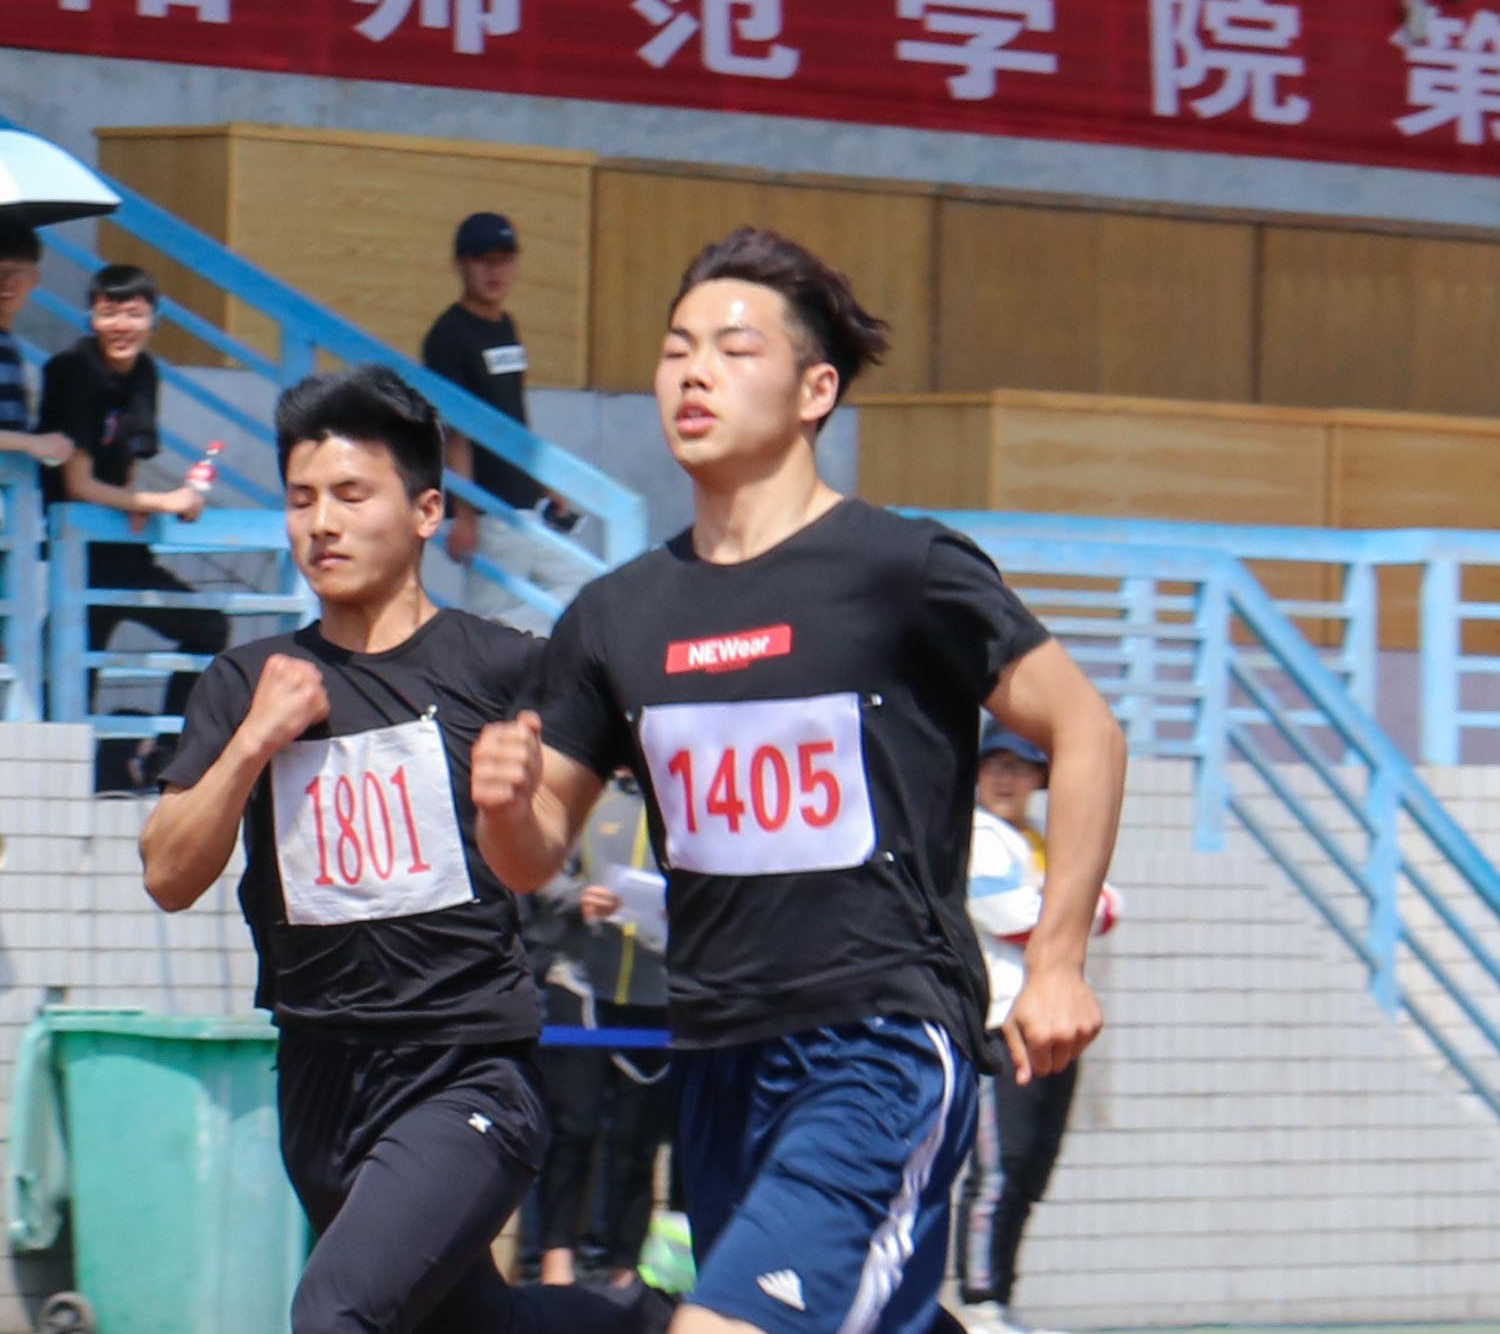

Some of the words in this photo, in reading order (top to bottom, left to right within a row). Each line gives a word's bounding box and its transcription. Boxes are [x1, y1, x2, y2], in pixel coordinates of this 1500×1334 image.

[688, 634, 770, 668] NEWear
[304, 765, 432, 887] 1801
[668, 740, 842, 834] 1405
